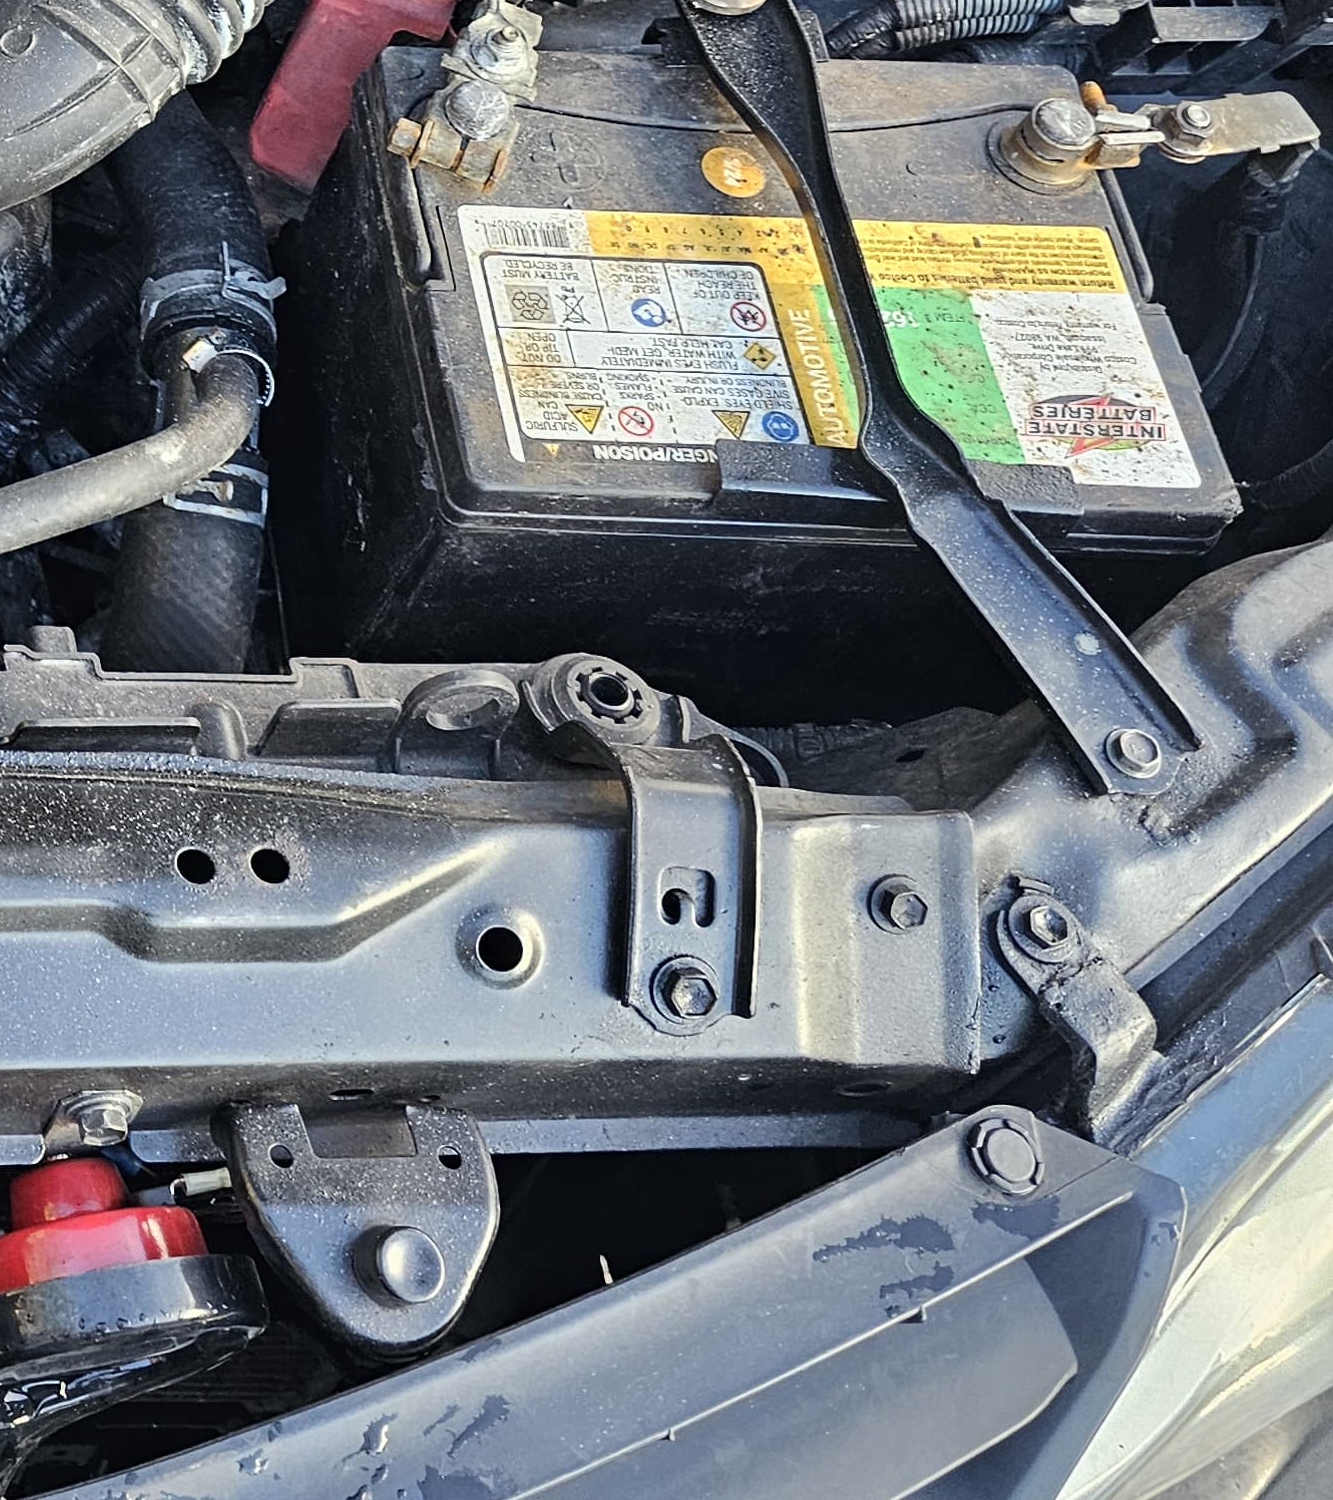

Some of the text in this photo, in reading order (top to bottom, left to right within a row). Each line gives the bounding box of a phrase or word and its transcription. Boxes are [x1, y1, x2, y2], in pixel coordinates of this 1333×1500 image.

[501, 269, 531, 280] MUST
[1079, 279, 1116, 290] Return
[708, 290, 730, 299] OUT
[788, 309, 847, 445] AUTOMOTIVE
[704, 387, 725, 396] CAN
[647, 401, 663, 412] NO
[725, 398, 751, 409] EYES
[543, 411, 568, 421] ACID
[1031, 405, 1153, 422] BATTERIES
[524, 421, 578, 432] SULFURIC
[1027, 421, 1163, 439] INTERSTATE
[591, 444, 718, 463] NGER/POISON
